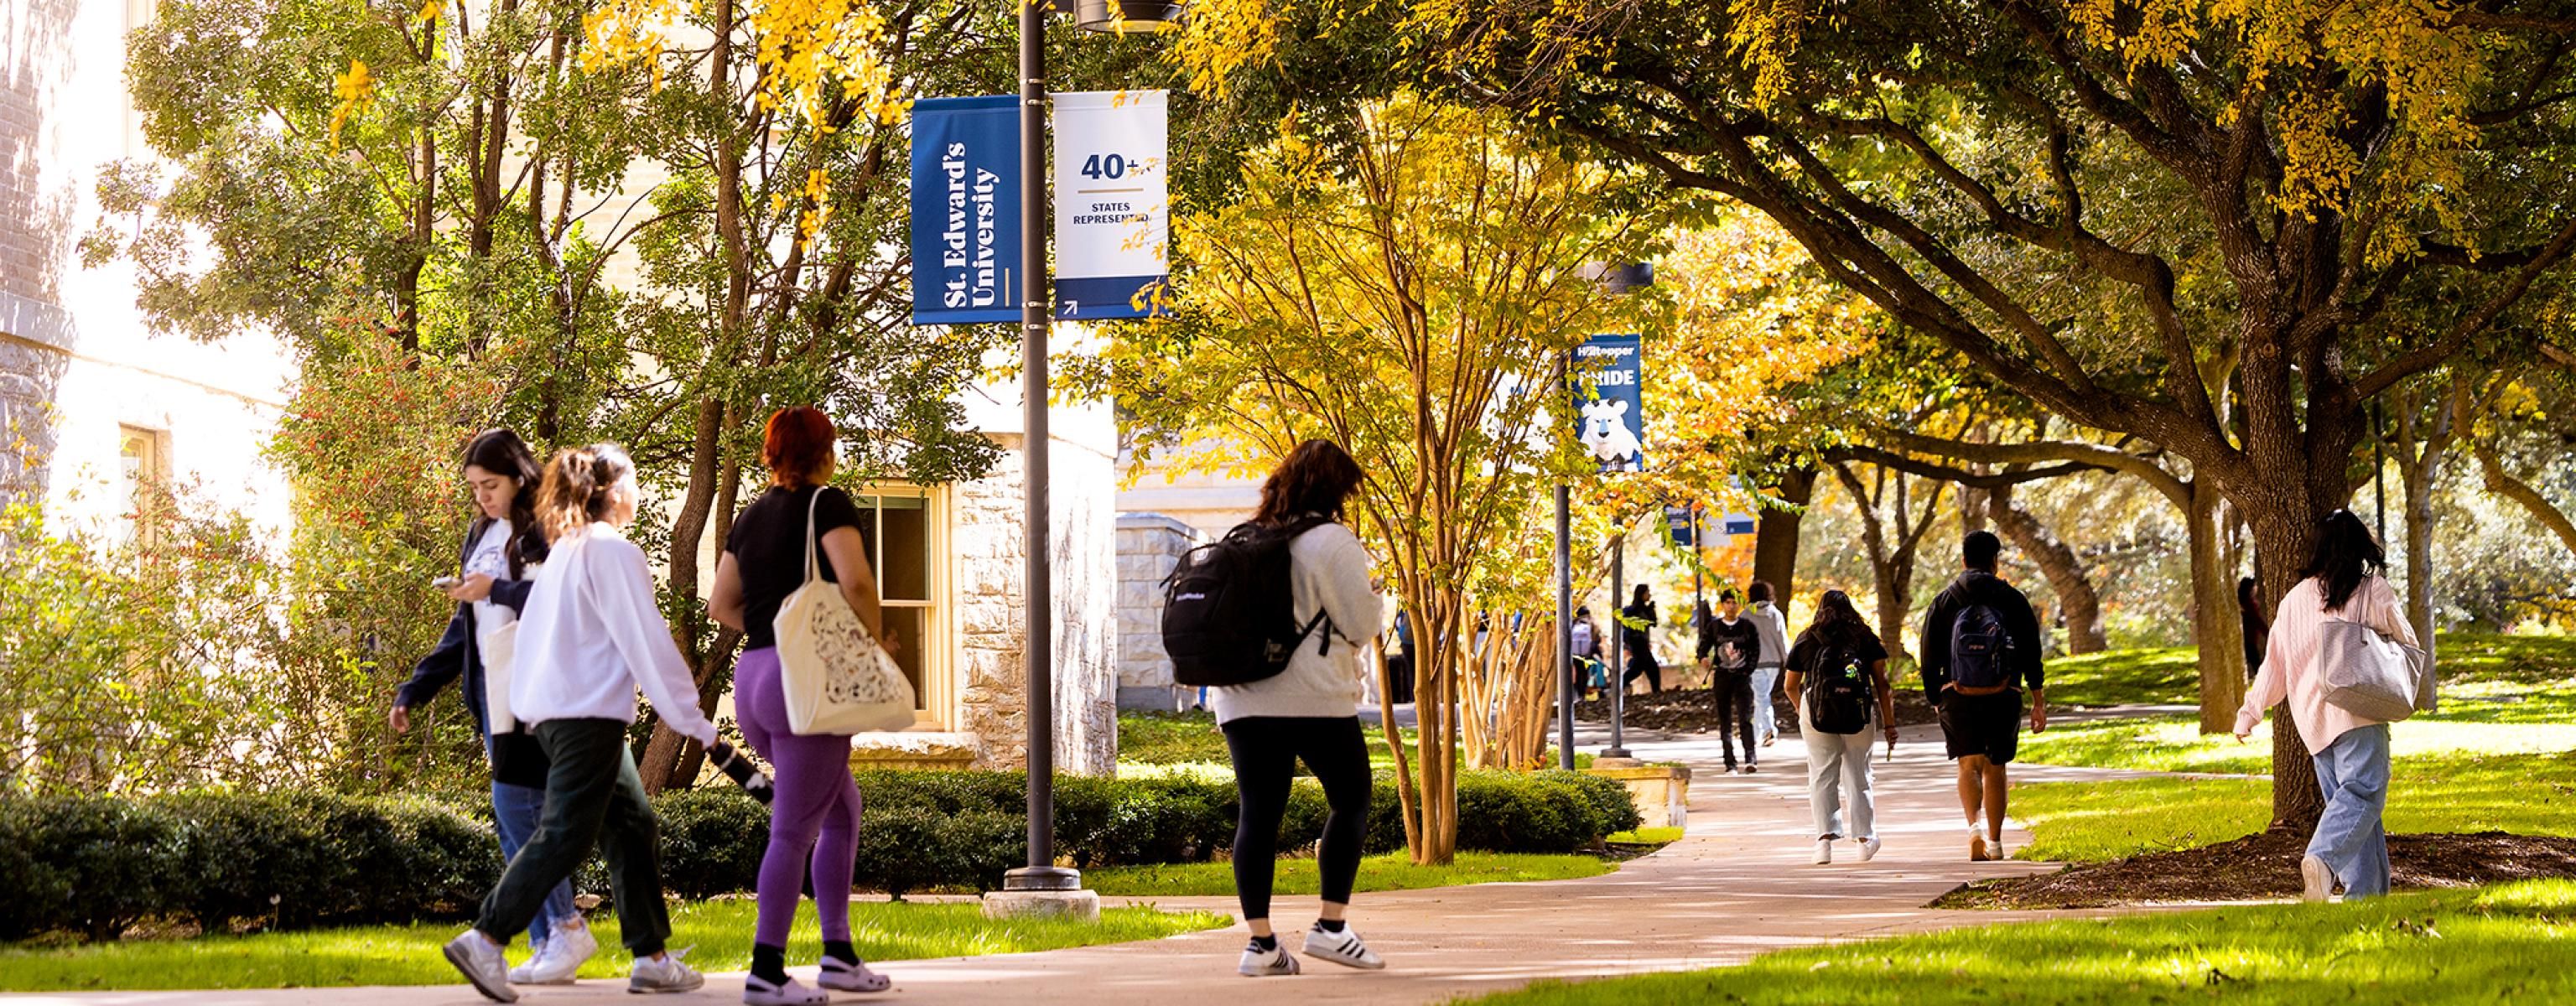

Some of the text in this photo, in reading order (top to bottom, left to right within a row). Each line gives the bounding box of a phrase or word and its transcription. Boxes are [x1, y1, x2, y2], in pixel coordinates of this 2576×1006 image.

[1081, 153, 1139, 179] 40+
[1091, 203, 1130, 212] STATES
[943, 142, 966, 308] St. Edward's
[1073, 215, 1149, 224] REPRESENTD
[973, 168, 1000, 308] University
[1577, 345, 1634, 358] Hilltopper
[1578, 370, 1634, 386] PRIDE
